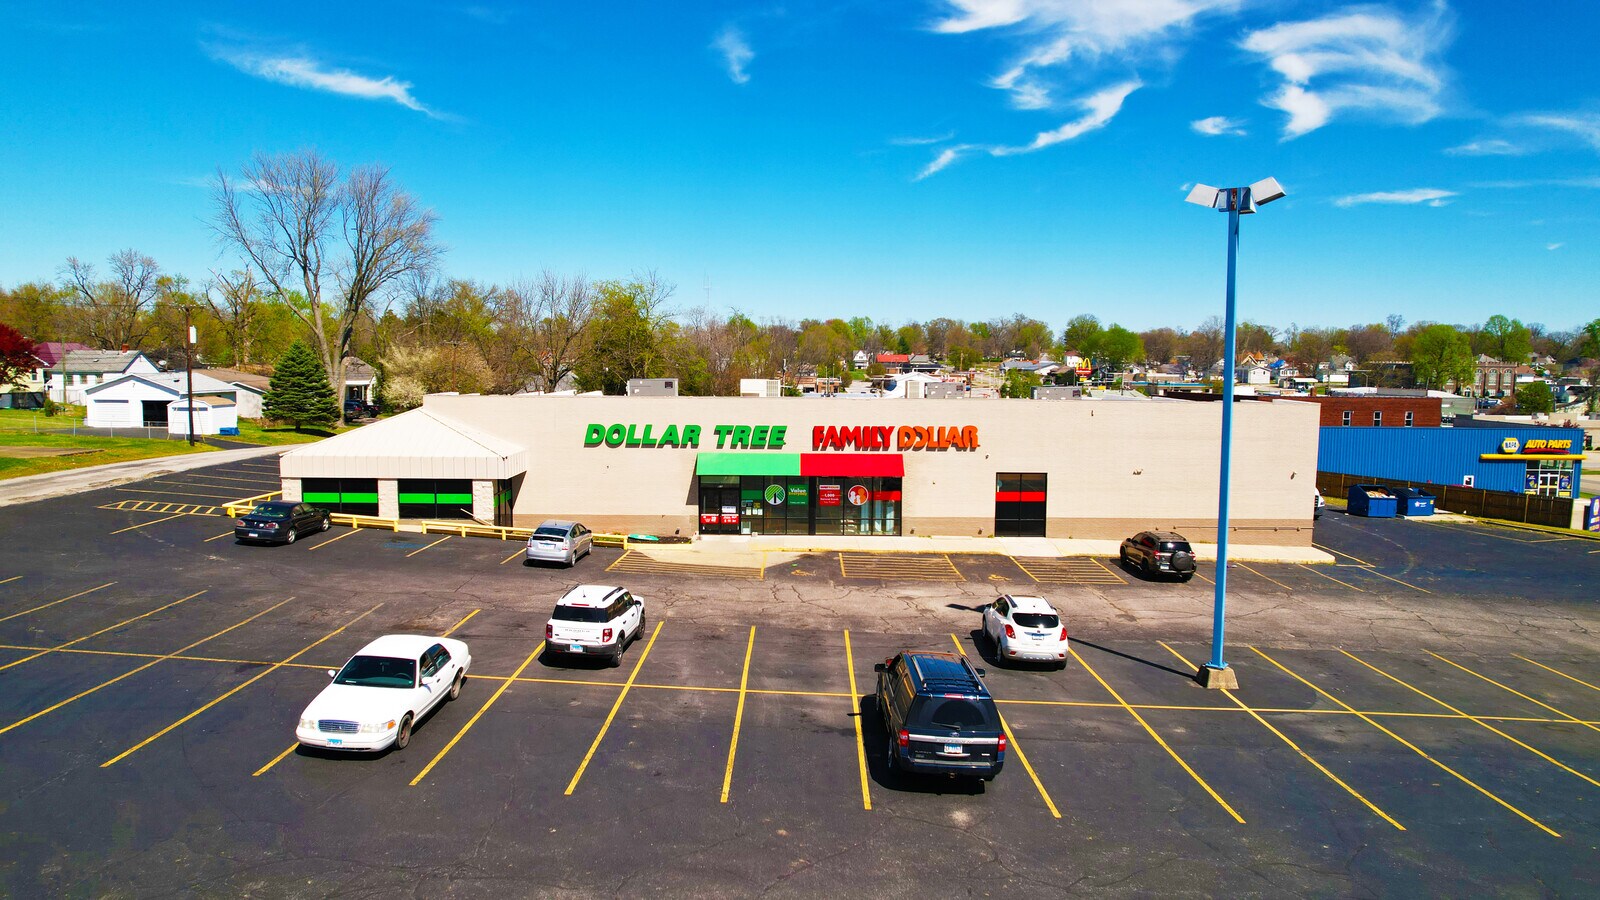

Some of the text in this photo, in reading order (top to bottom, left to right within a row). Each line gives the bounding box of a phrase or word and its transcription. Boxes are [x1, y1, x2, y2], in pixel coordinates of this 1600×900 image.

[584, 424, 788, 449] DOLLAR TREE
[812, 425, 979, 452] FAMILY DOLLAR
[1525, 440, 1572, 448] AUTO PARTS
